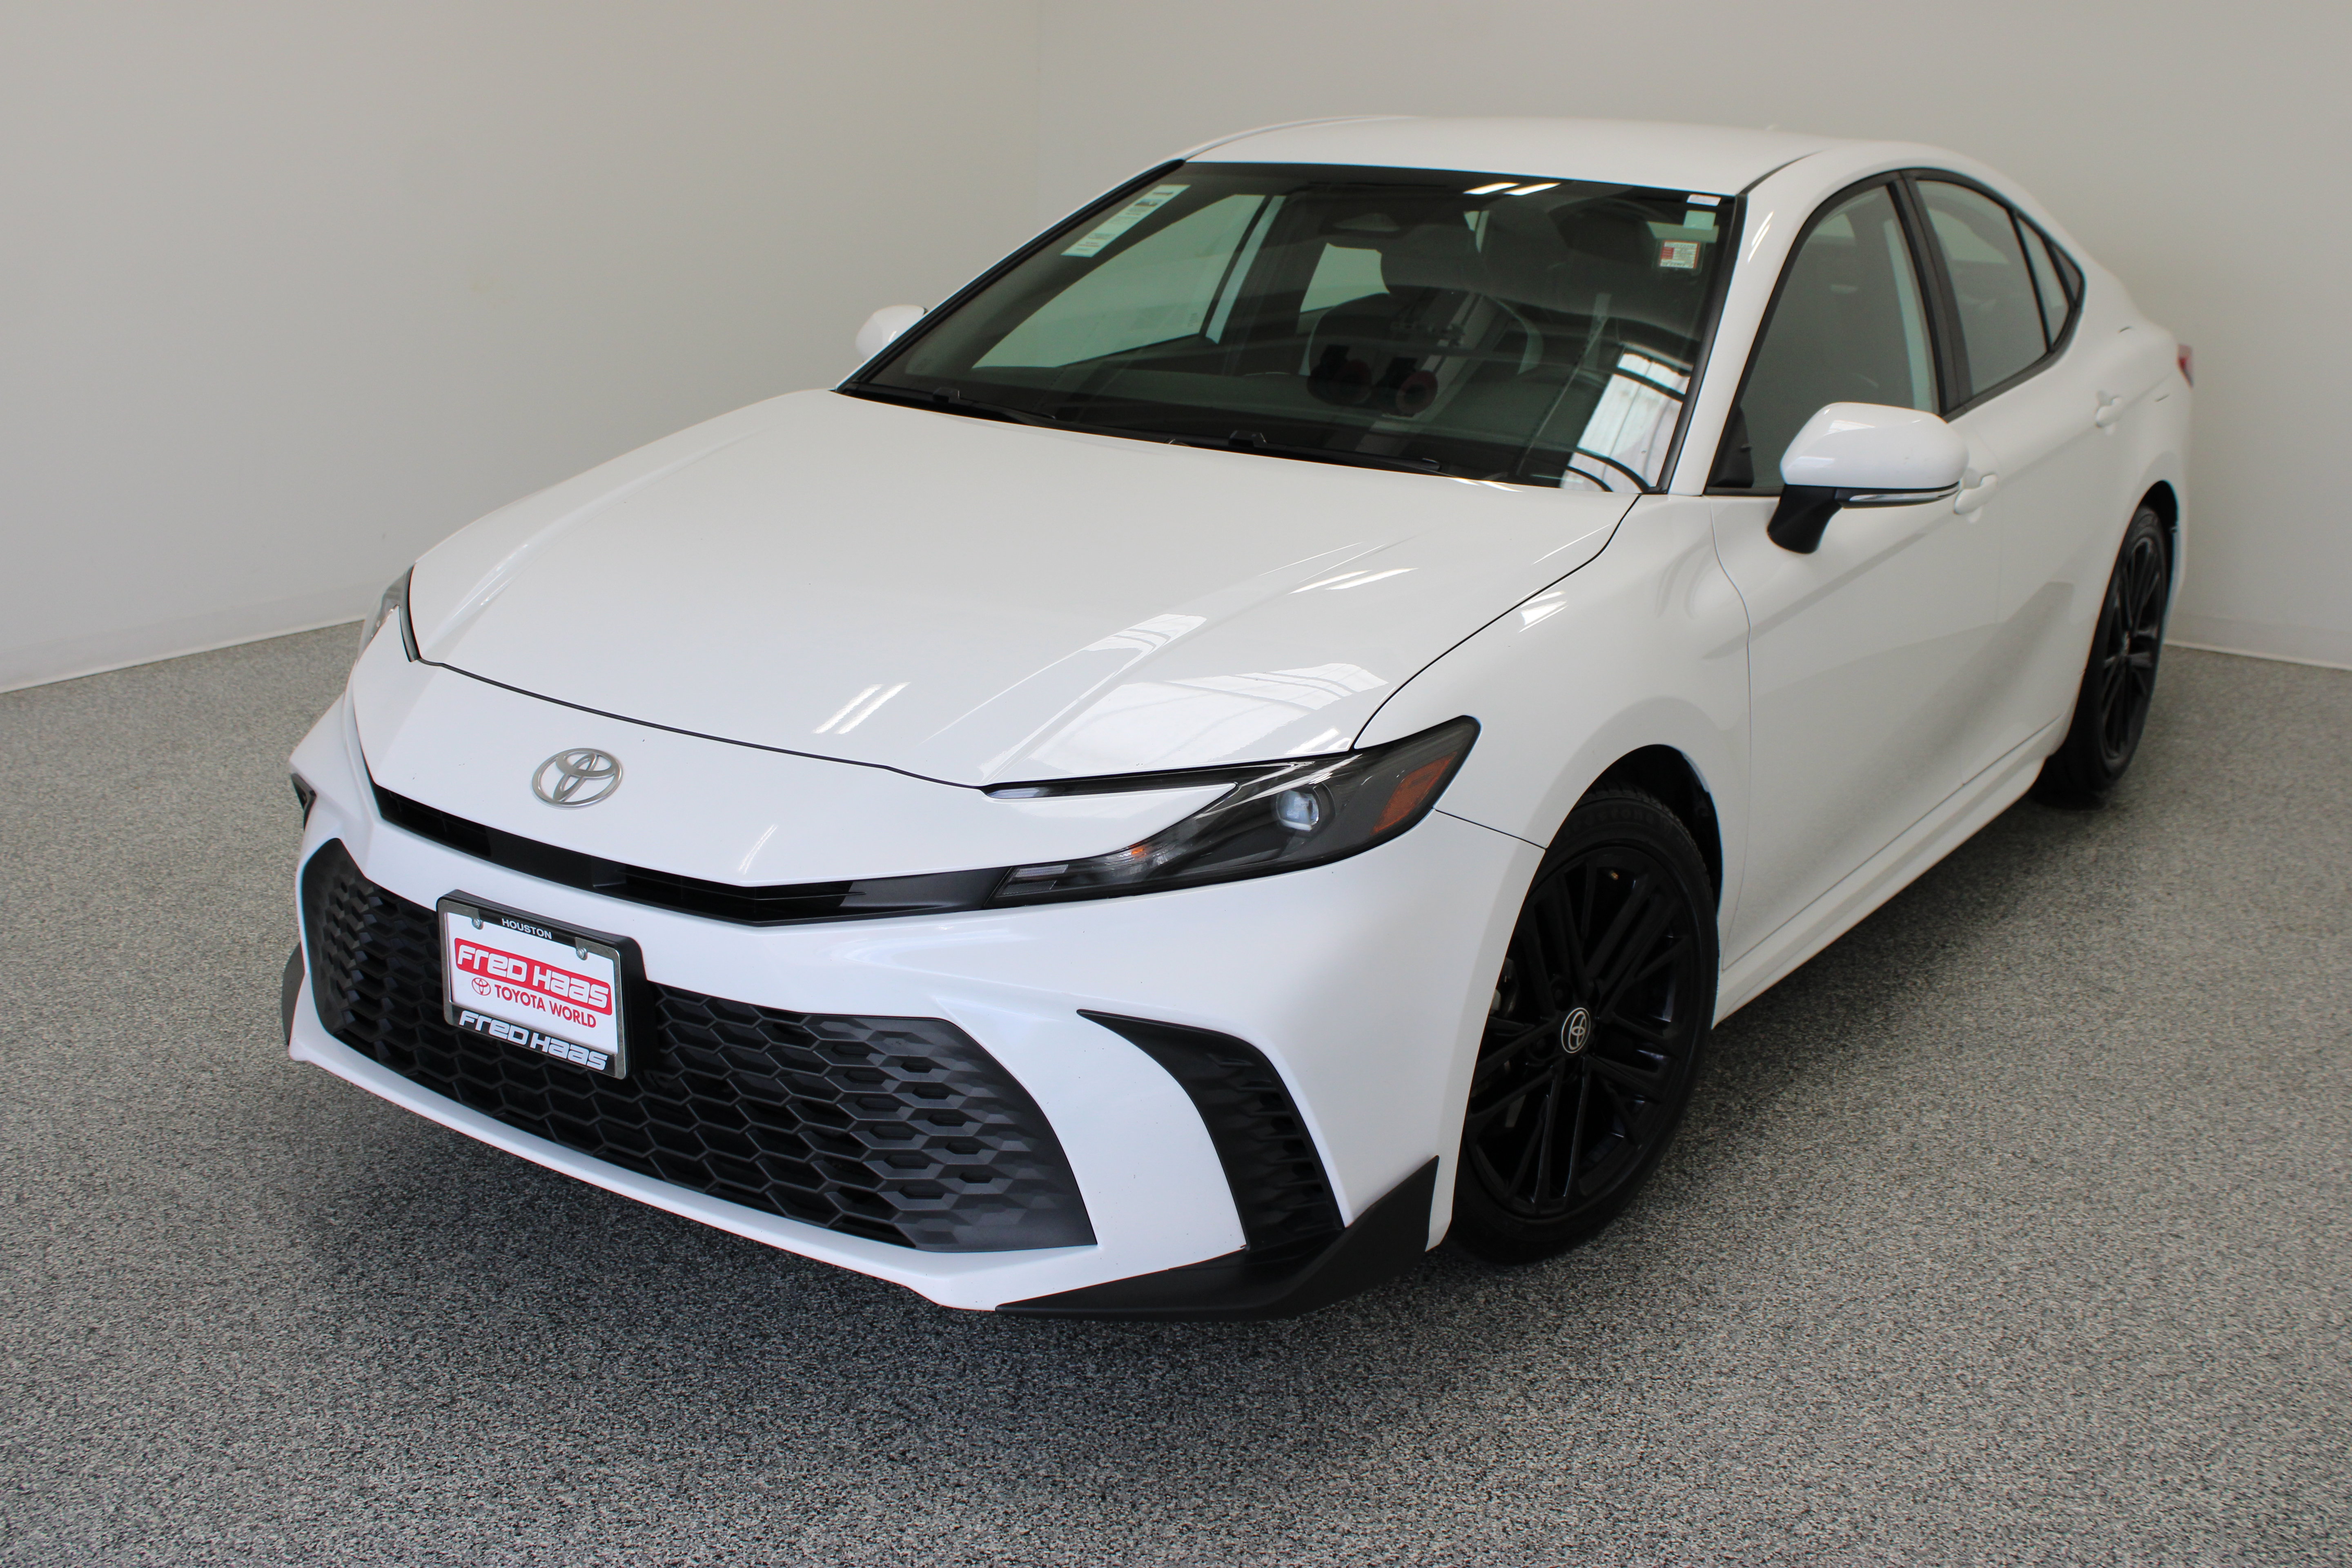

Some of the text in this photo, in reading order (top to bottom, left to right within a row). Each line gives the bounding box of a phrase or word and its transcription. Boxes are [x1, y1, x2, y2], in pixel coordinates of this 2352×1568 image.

[501, 918, 552, 939] HOUSTON
[494, 984, 597, 1028] TOYOTA WORLD
